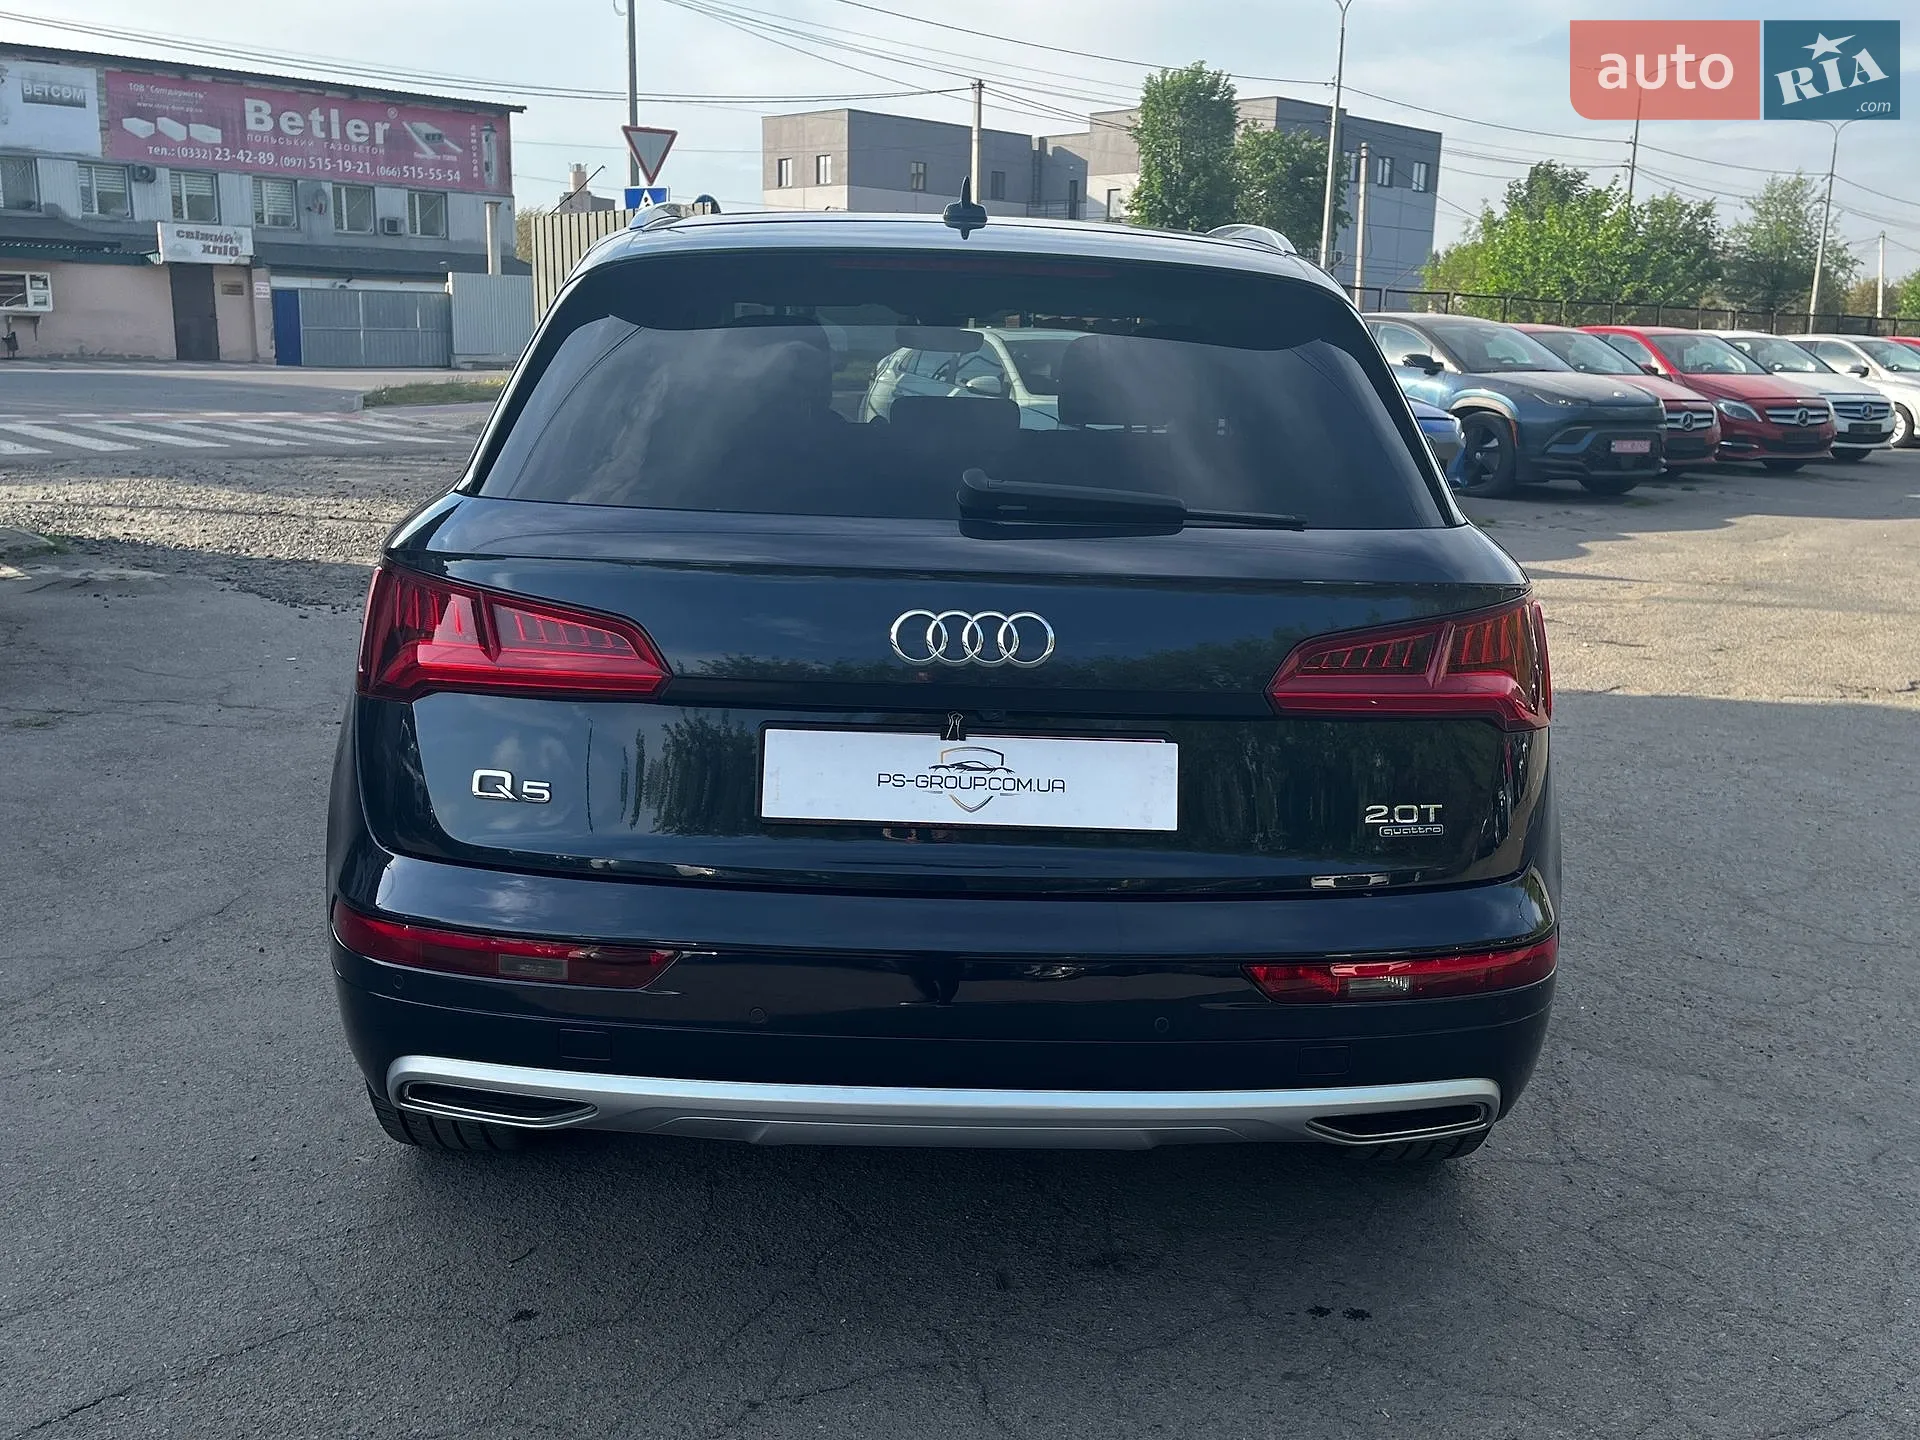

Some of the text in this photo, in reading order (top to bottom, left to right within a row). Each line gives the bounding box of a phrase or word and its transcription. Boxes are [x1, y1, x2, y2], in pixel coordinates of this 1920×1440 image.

[244, 98, 390, 145] Betler
[471, 768, 551, 803] Q5
[877, 773, 1066, 794] PS-GROUP.COM.UA
[1364, 804, 1443, 823] 2.0T
[1383, 826, 1442, 836] quattro
